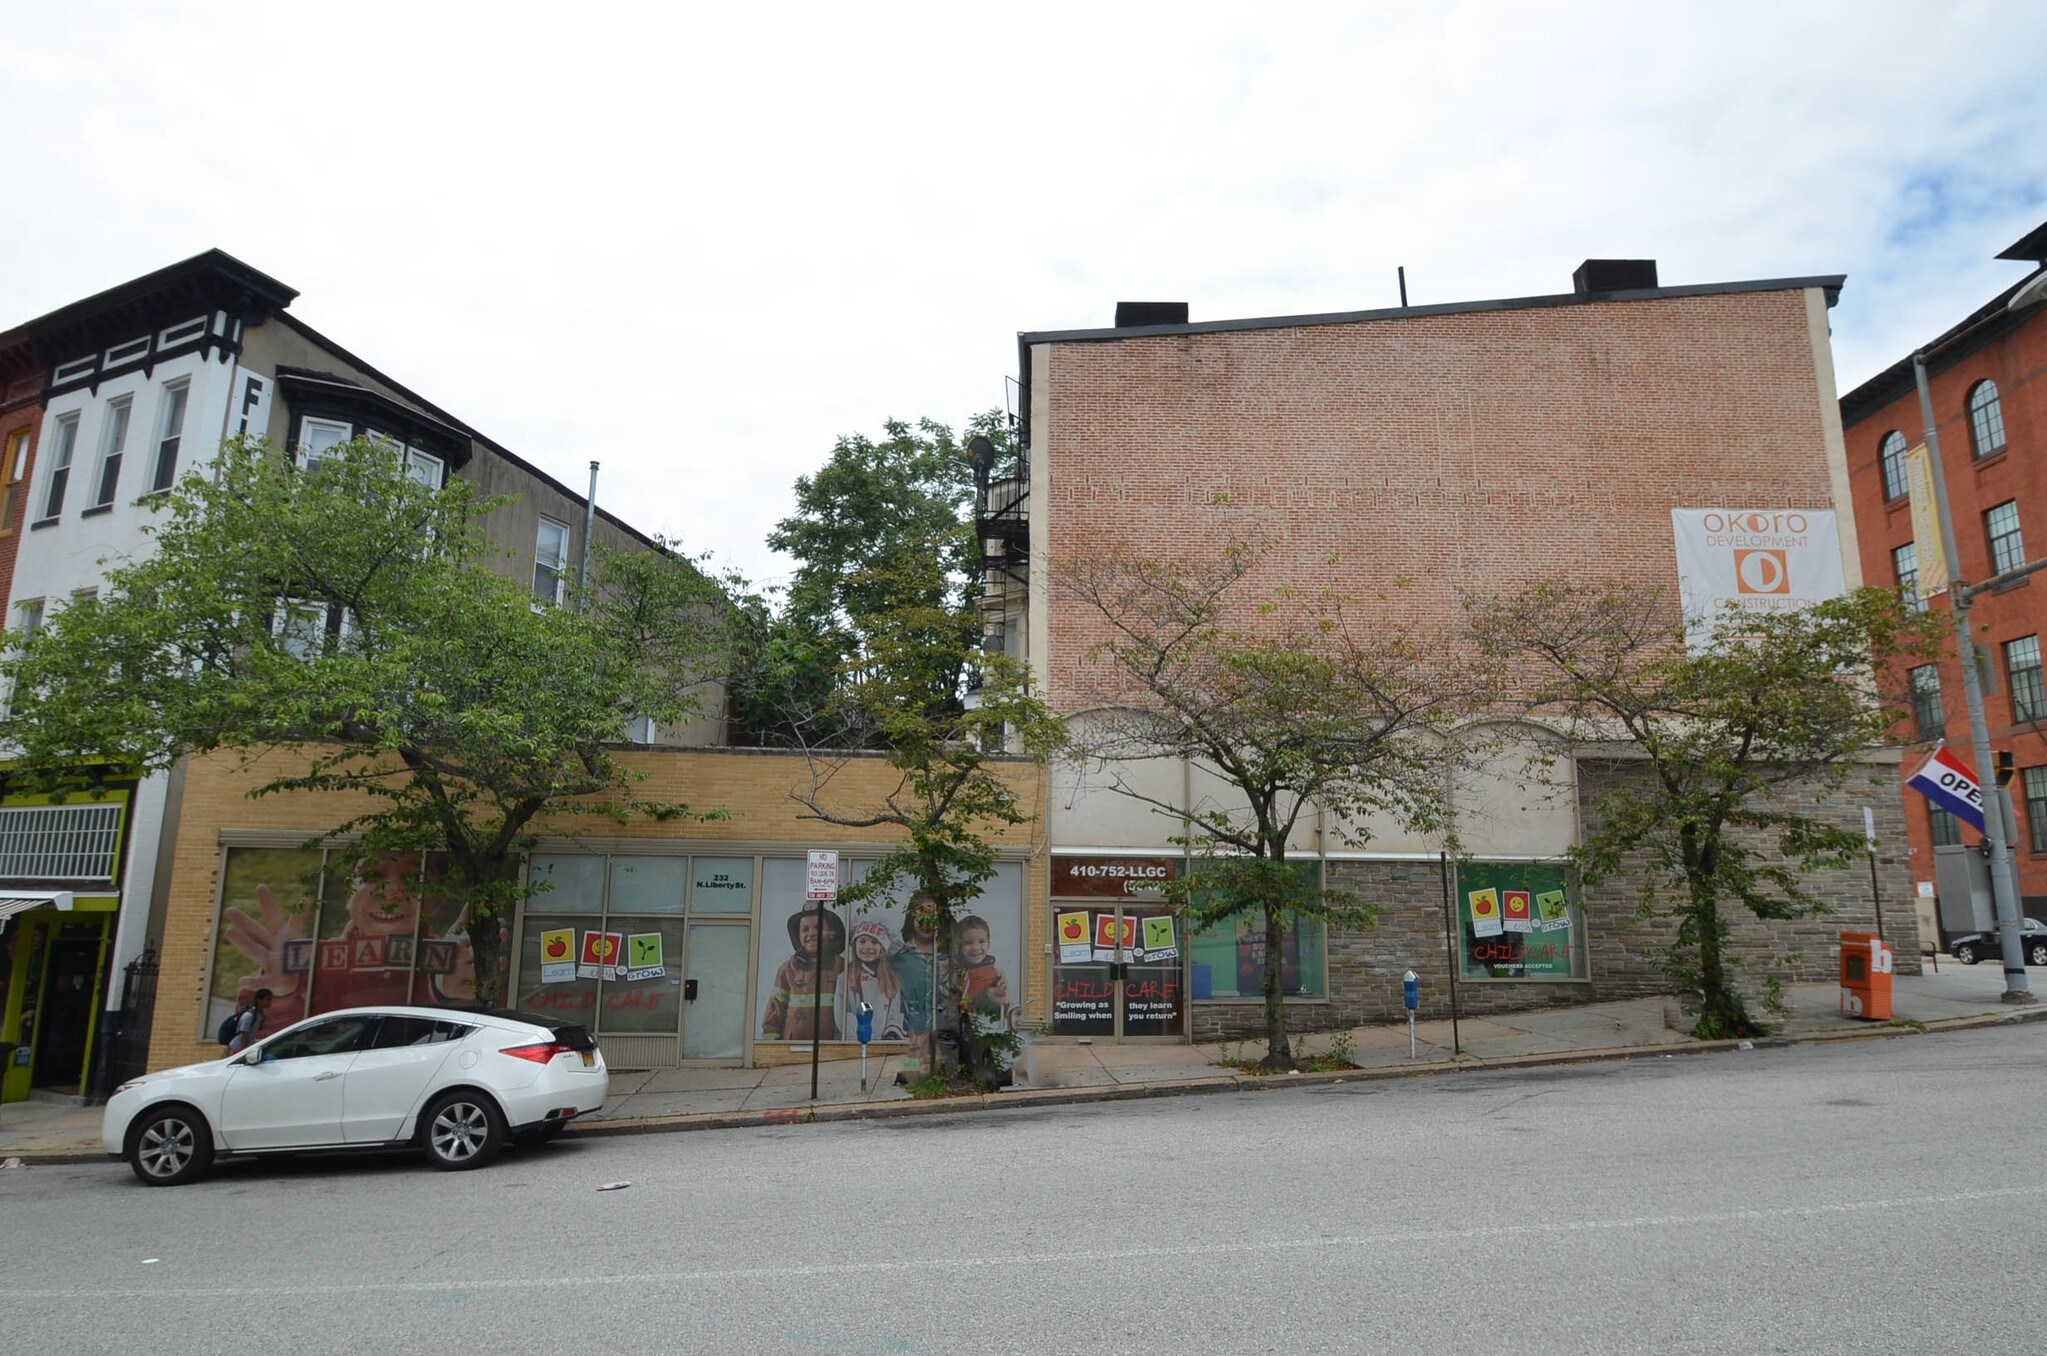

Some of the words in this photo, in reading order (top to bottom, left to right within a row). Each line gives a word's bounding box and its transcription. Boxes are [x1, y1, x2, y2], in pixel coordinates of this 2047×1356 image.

[1706, 535, 1808, 547] DEVELOPMENT
[1940, 772, 1984, 807] OPE
[819, 853, 827, 861] NO
[810, 862, 835, 870] PARKING
[1069, 865, 1166, 877] 410-752-LLGC
[293, 939, 449, 968] LEARN
[1870, 939, 1893, 974] b
[1054, 980, 1115, 999] CHILD
[1125, 980, 1178, 999] CARE
[527, 990, 597, 1010] CHILD
[605, 989, 665, 1010] CARE
[1129, 1002, 1148, 1010] they
[1054, 1012, 1087, 1021] Smiling
[1128, 1013, 1144, 1021] you
